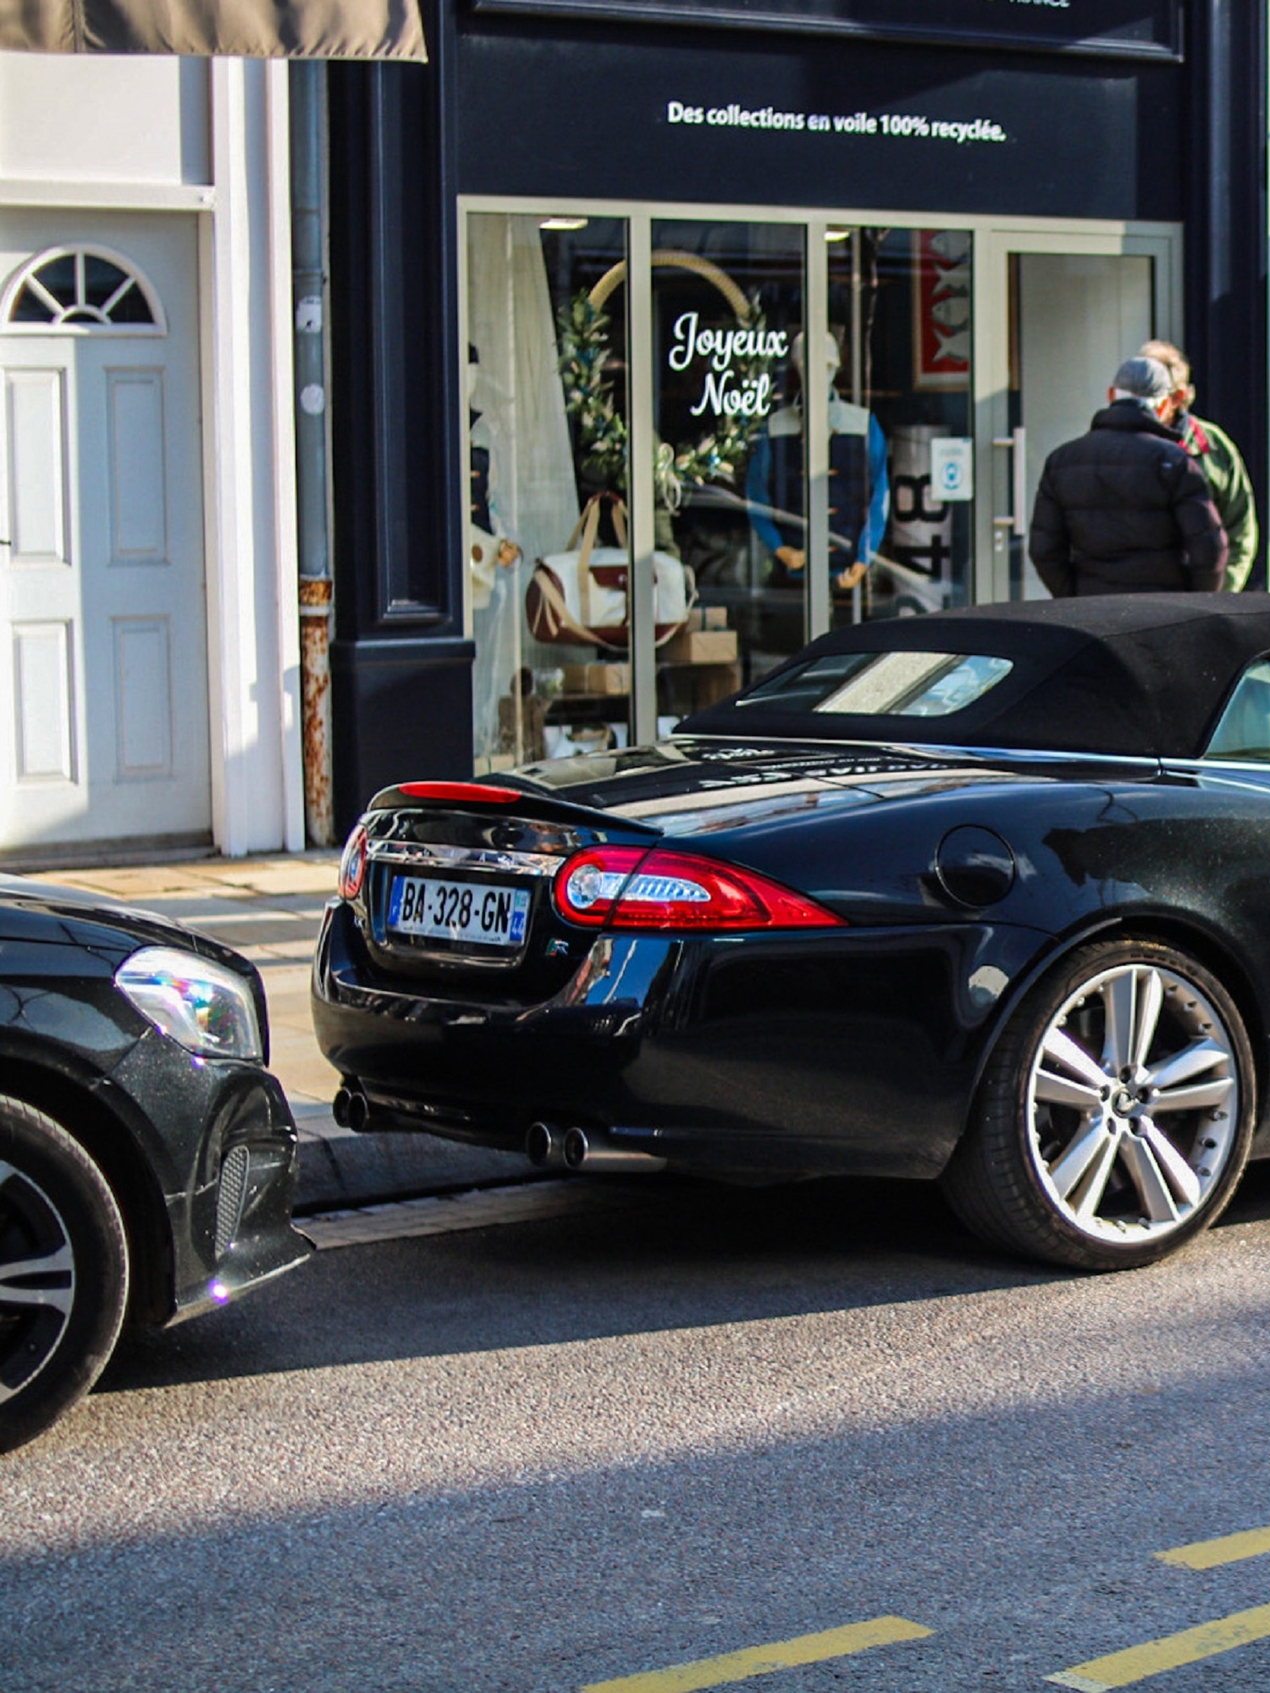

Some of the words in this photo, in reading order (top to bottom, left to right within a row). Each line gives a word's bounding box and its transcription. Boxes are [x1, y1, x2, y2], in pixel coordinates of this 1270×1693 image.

[668, 102, 703, 123] Des
[706, 105, 804, 130] collections
[807, 114, 831, 131] en
[834, 112, 877, 133] voile
[879, 114, 929, 136] 100%
[931, 119, 1006, 142] recyclée.
[668, 311, 789, 371] Joyeux
[689, 369, 771, 416] Noël
[402, 882, 512, 934] BA-328-GN
